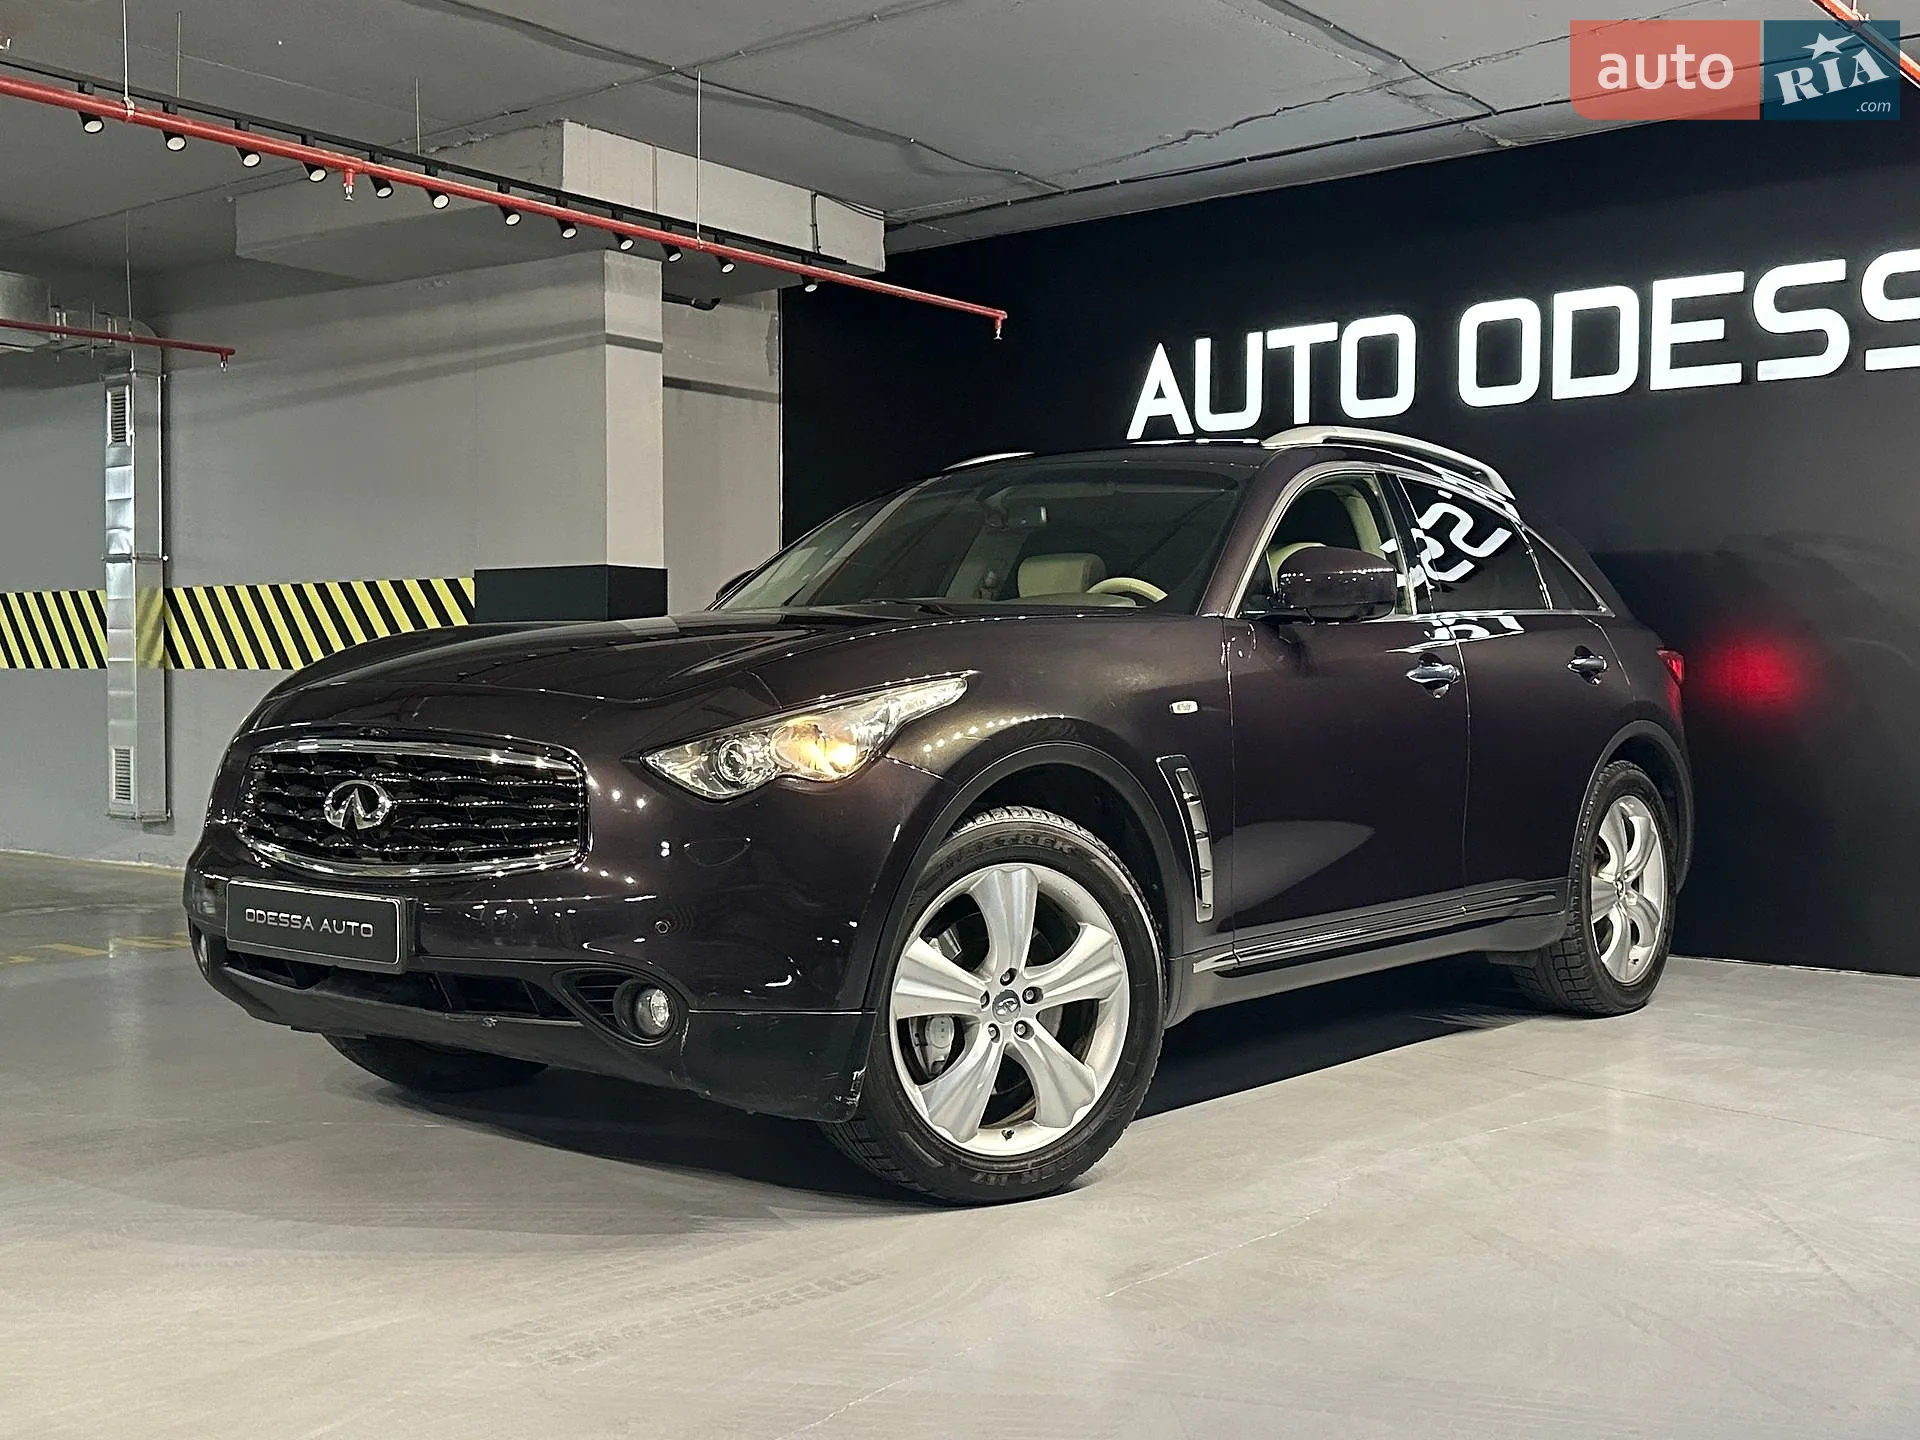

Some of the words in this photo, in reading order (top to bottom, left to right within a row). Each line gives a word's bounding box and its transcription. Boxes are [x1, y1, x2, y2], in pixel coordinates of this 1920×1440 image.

[1127, 313, 1417, 440] AUTO
[245, 908, 315, 931] ODESSA
[319, 917, 374, 938] AUTO
